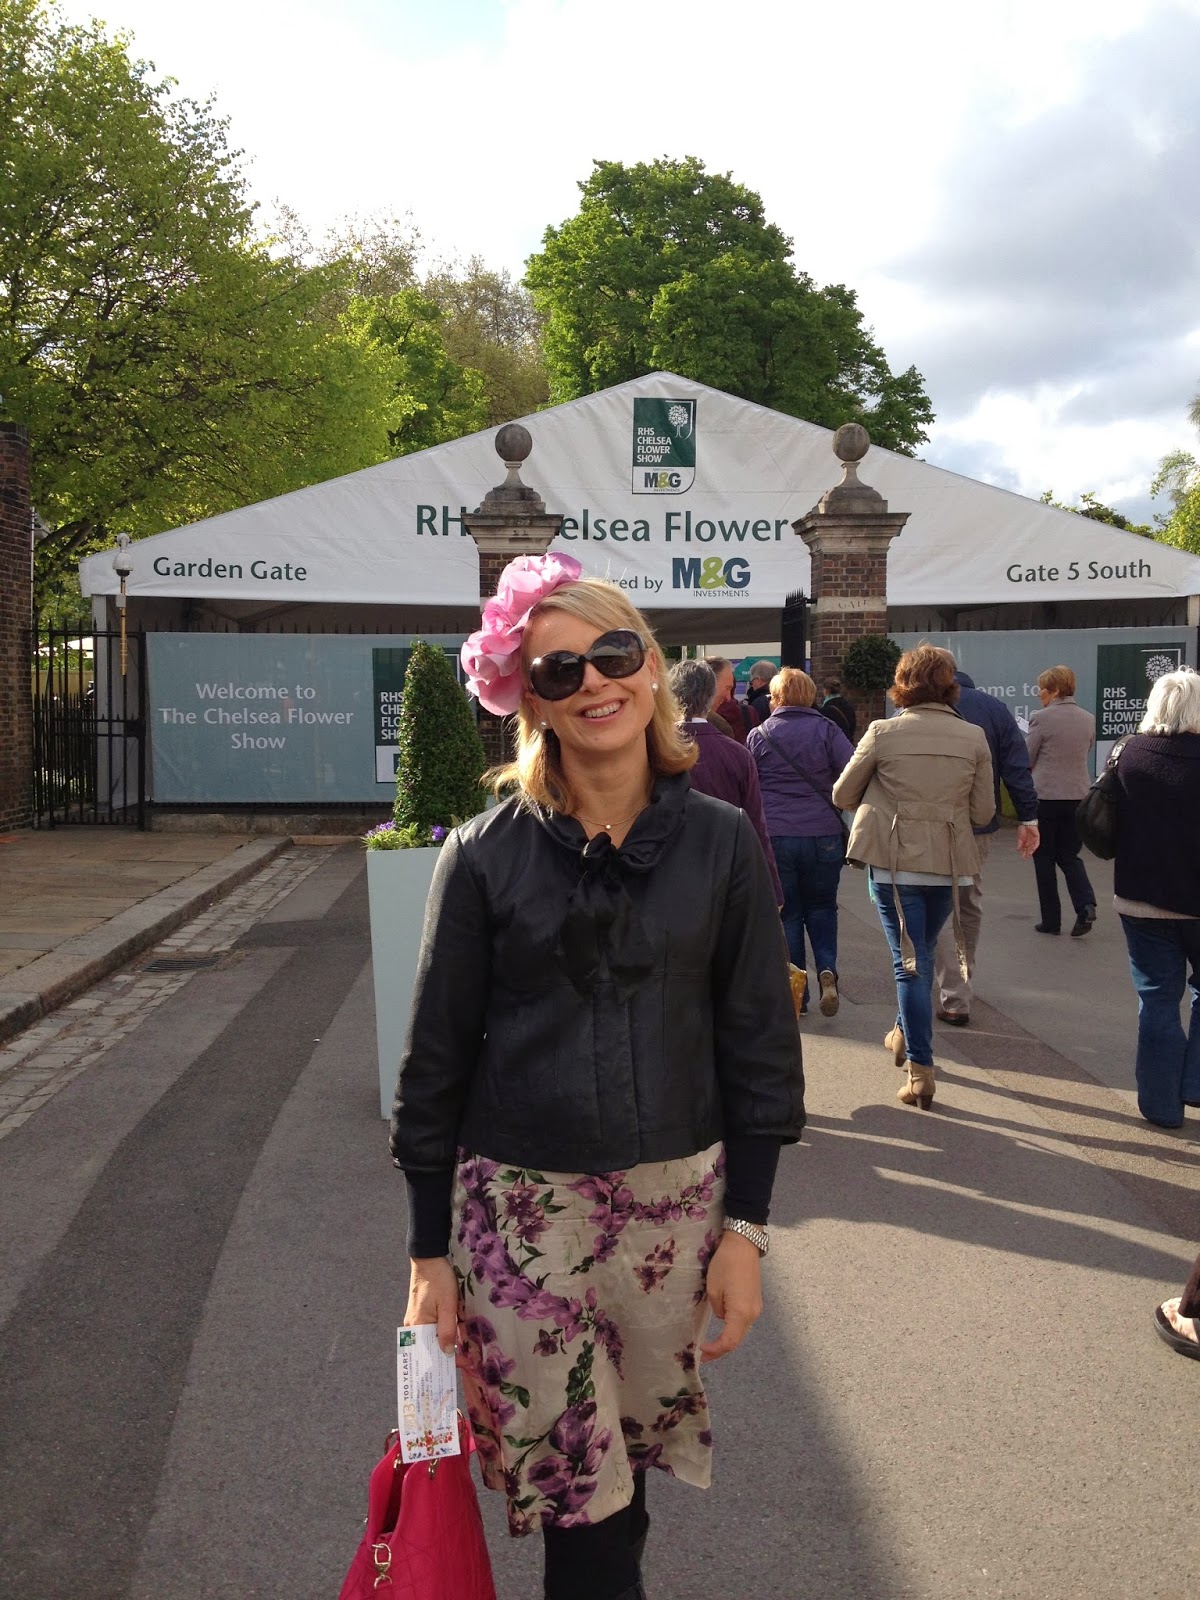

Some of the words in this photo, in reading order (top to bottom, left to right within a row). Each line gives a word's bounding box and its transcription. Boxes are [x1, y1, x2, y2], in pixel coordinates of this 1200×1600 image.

[637, 427, 655, 436] RHS
[637, 436, 672, 445] CHELSEA
[637, 445, 671, 454] FLOWER
[636, 455, 662, 463] SHOW
[644, 471, 681, 488] M&G
[416, 504, 481, 536] RH
[558, 508, 650, 541] elsea
[665, 510, 789, 542] Flower
[153, 556, 243, 579] Garden
[250, 560, 307, 581] Gate
[644, 575, 663, 593] by
[672, 556, 751, 589] M&G
[1006, 564, 1059, 582] Gate
[1067, 562, 1080, 580] 5
[1087, 559, 1151, 580] South
[196, 683, 289, 699] Welcome
[295, 684, 316, 699] to
[380, 692, 405, 702] RHS
[1022, 682, 1041, 697] to
[1103, 687, 1127, 698] RHS
[158, 708, 197, 724] The
[203, 708, 281, 724] Chelsea
[288, 708, 354, 724] Flower
[381, 717, 401, 727] FLO
[1101, 723, 1137, 735] SHOW
[231, 733, 286, 749] Show
